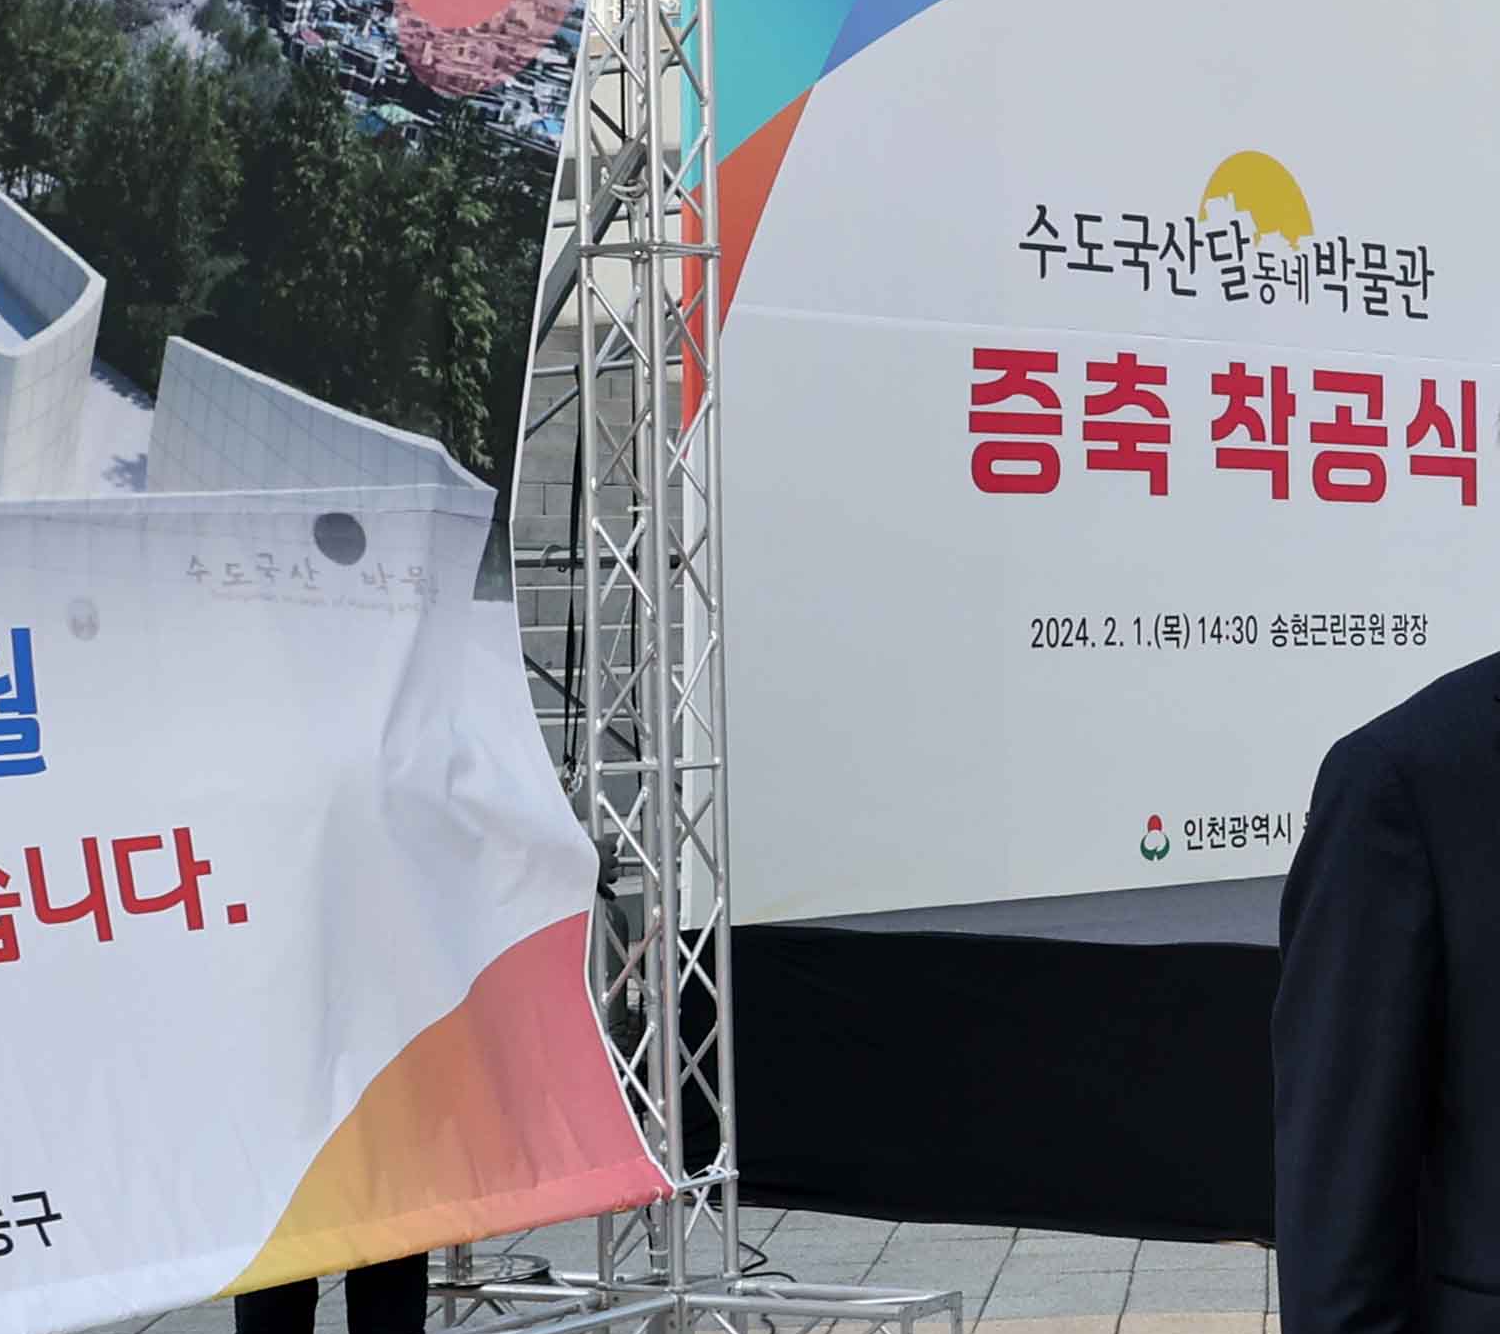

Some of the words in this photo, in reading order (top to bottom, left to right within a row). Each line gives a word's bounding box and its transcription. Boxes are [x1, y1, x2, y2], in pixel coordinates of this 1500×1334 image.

[1019, 205, 1435, 320] 수도국산달동네박물관
[969, 348, 1171, 496] 증축
[1211, 362, 1477, 506] 착공식
[186, 552, 320, 590] 수도국산
[1031, 617, 1096, 649] 2024.
[1197, 615, 1258, 645] 14:30
[1270, 613, 1385, 647] 송현근린공원
[1391, 613, 1429, 647] 광장
[1184, 812, 1292, 851] 인천광역시
